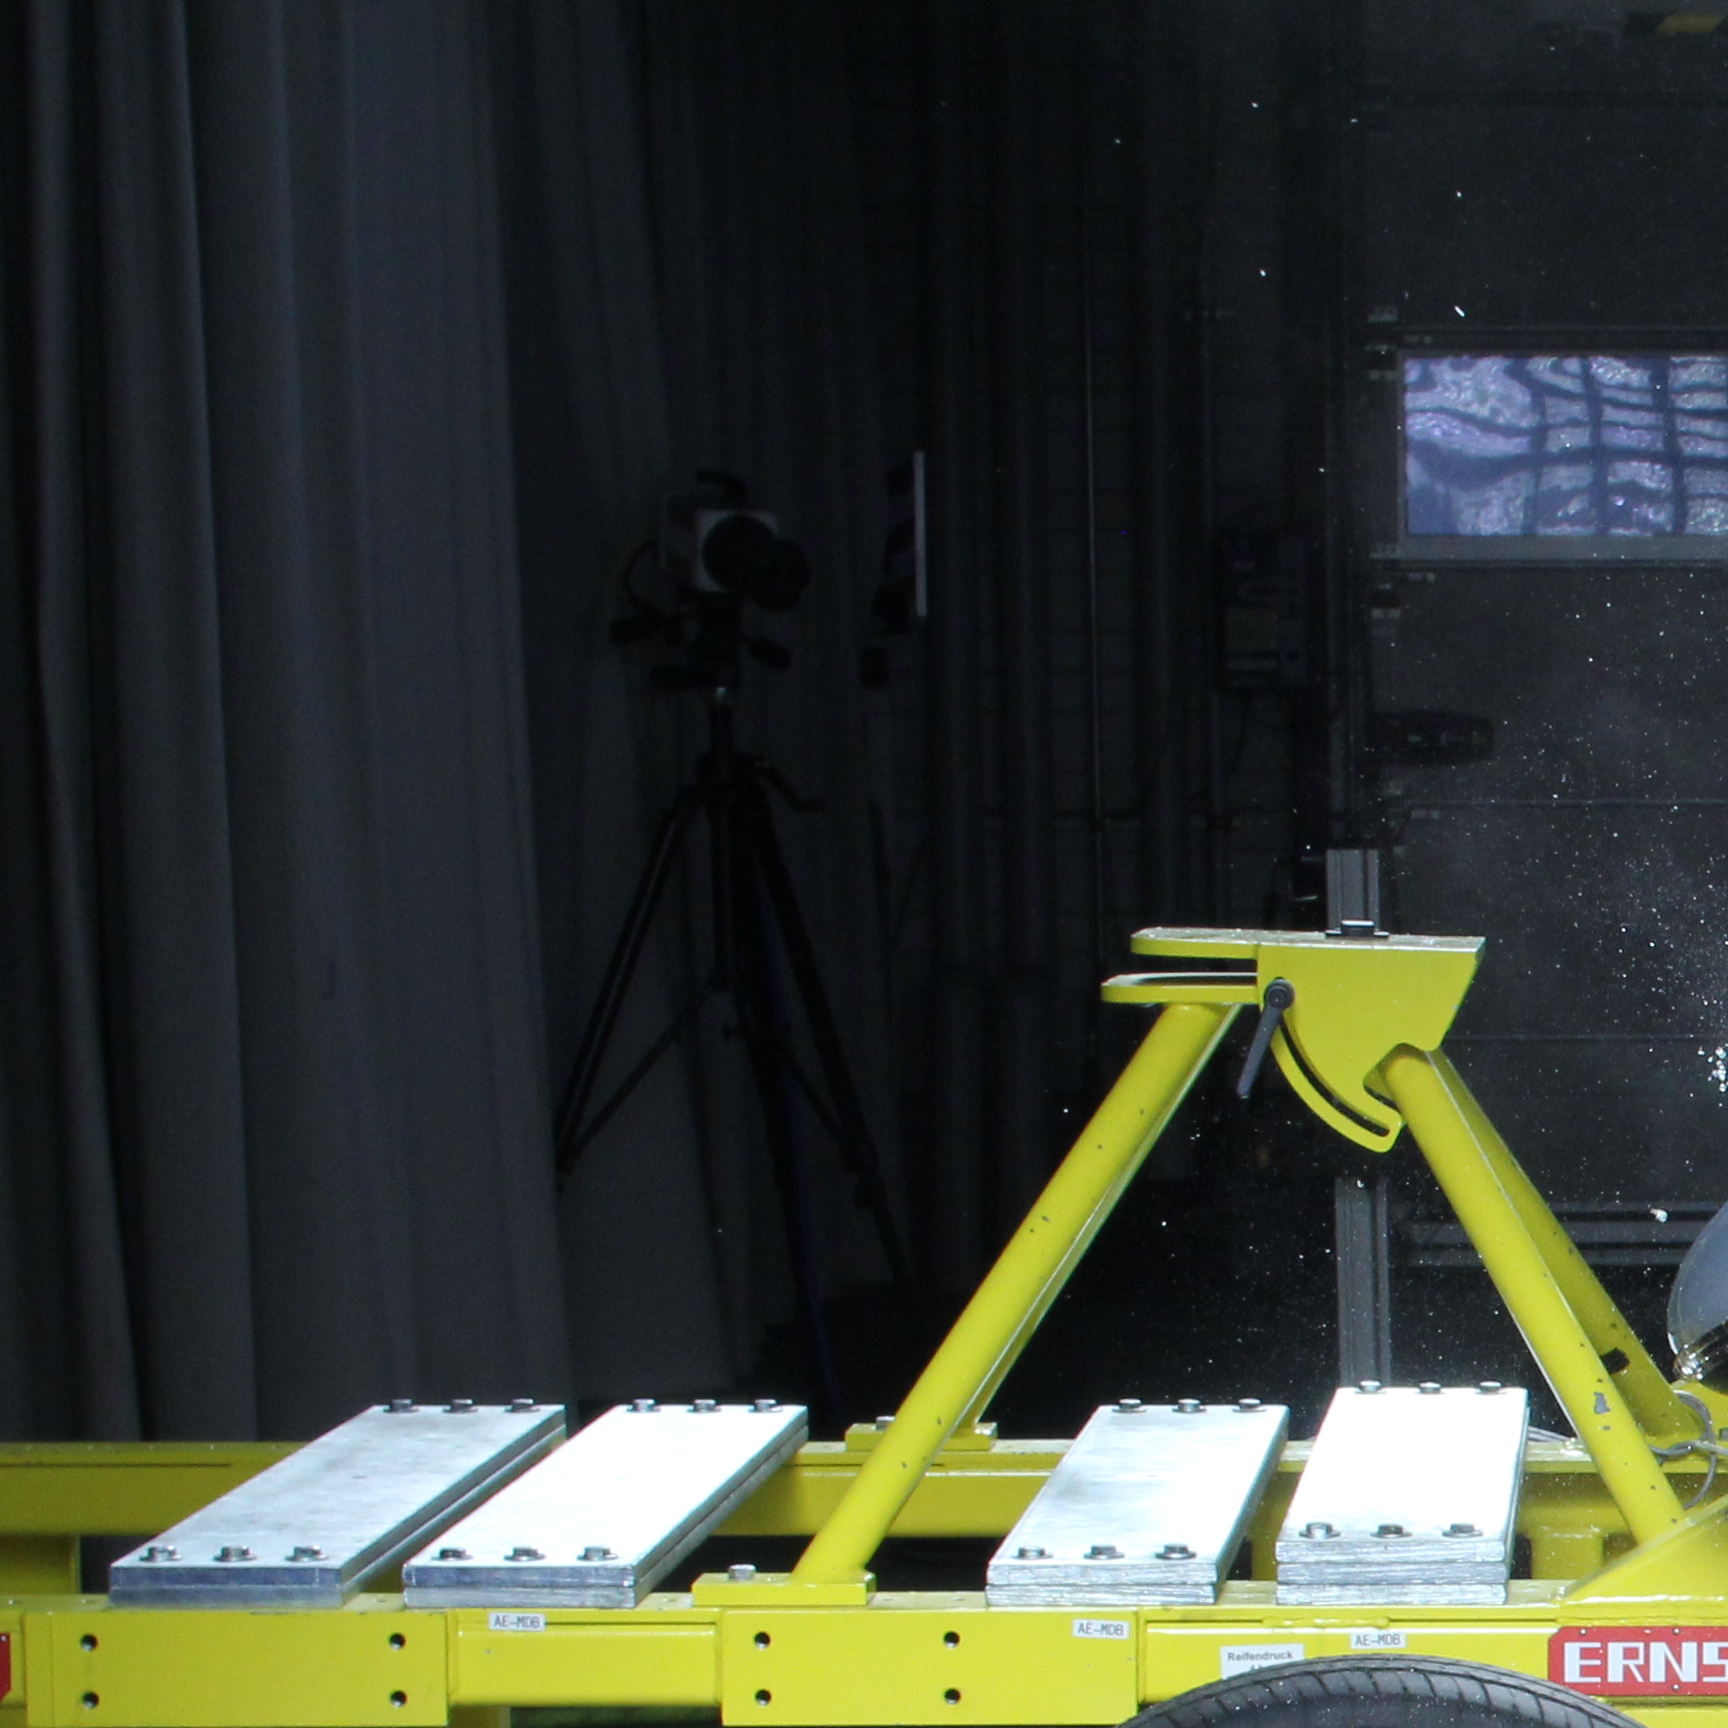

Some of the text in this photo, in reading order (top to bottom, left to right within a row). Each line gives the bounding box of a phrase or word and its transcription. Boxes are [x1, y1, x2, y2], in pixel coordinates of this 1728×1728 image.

[1077, 1622, 1124, 1636] AE-MDB
[1354, 1633, 1401, 1646] AE-MDB
[1227, 1650, 1293, 1661] Reifendruck
